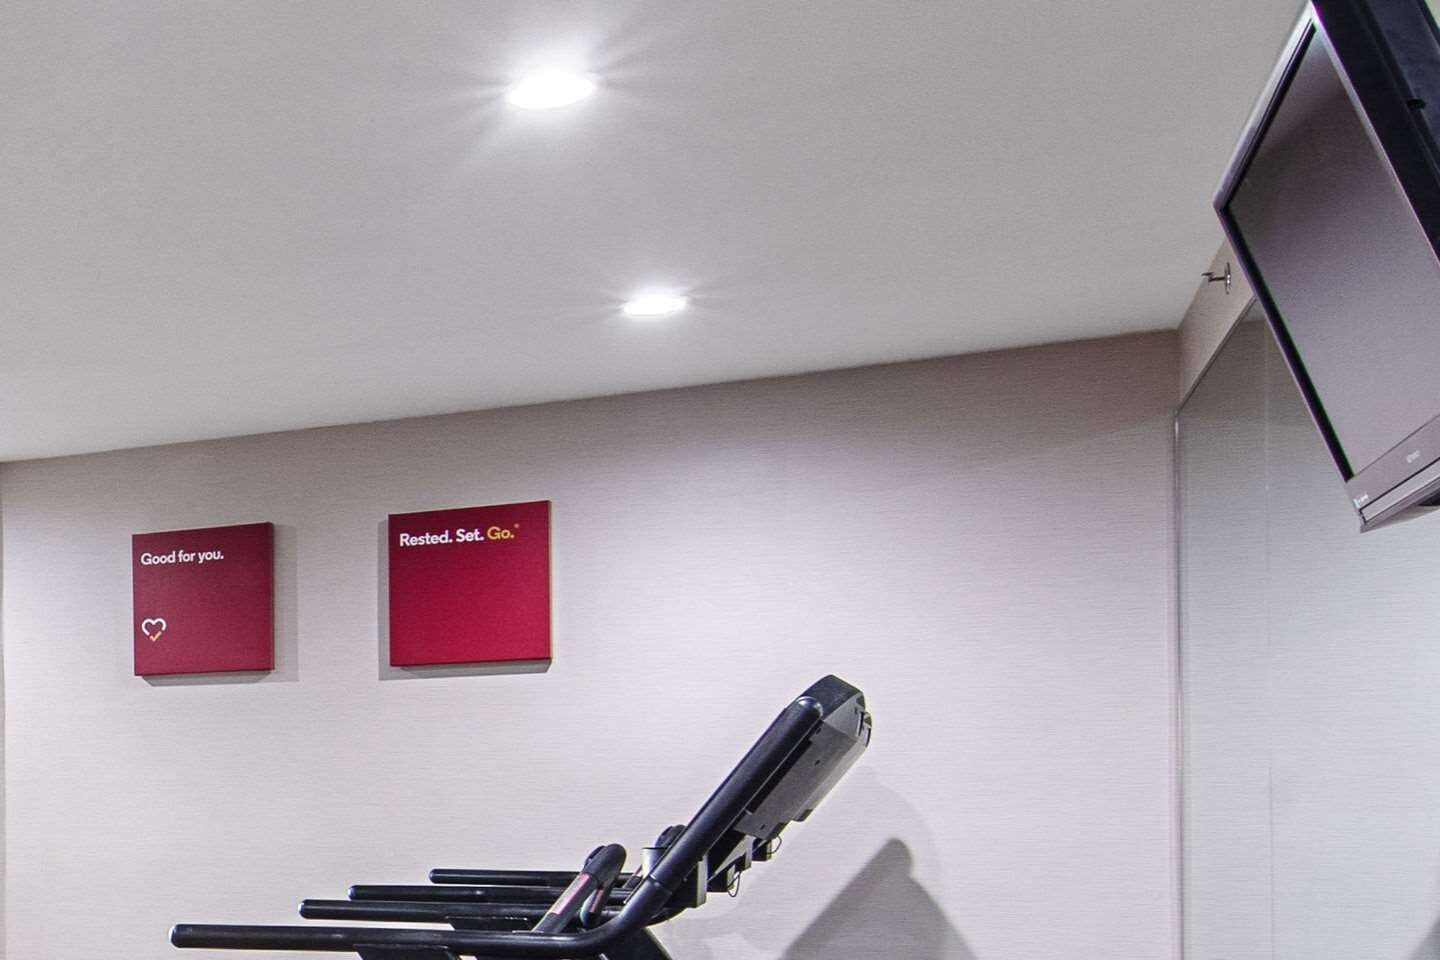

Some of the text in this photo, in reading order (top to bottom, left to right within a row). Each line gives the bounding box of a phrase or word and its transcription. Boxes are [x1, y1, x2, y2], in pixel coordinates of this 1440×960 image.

[399, 529, 453, 547] Rested.
[455, 528, 484, 542] Set.
[140, 549, 224, 566] Good for you.
